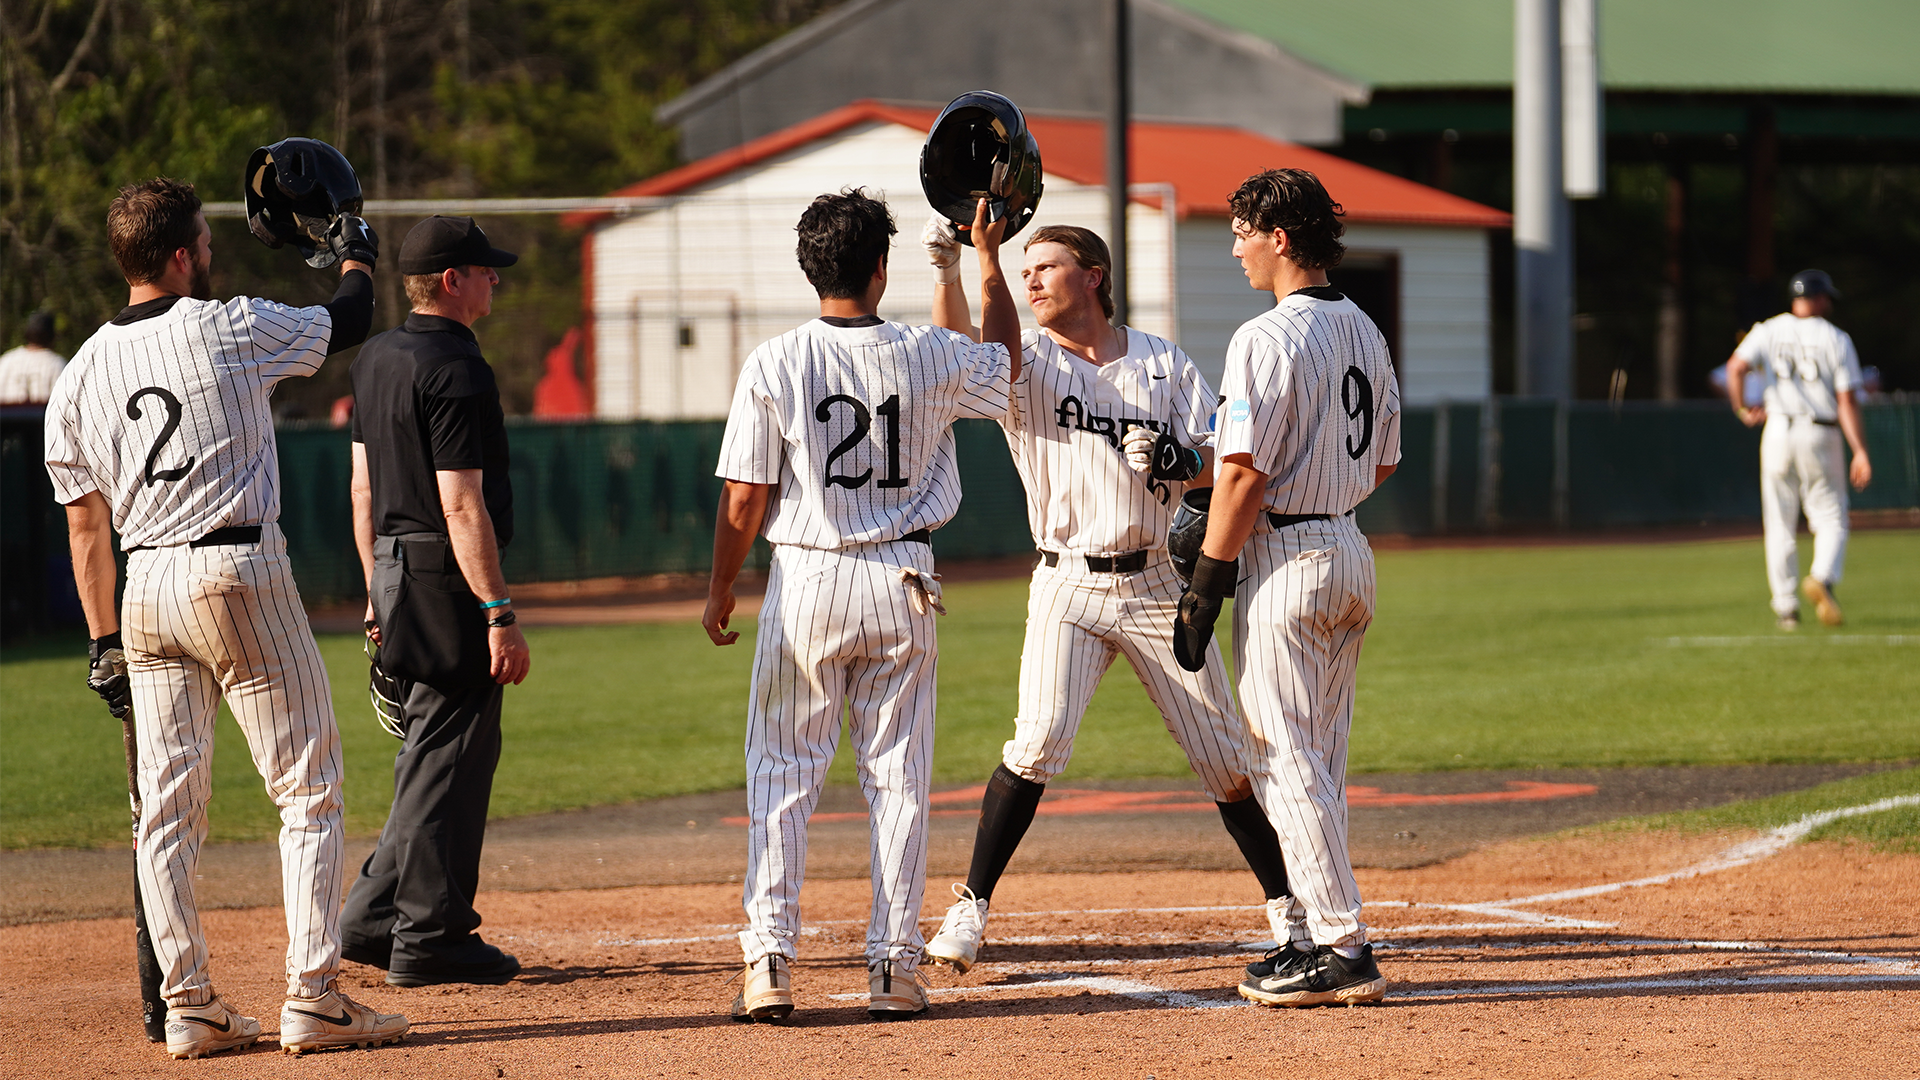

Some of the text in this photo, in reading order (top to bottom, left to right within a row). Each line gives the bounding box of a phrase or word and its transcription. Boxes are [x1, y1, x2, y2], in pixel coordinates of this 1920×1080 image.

[126, 386, 195, 488] 2
[815, 394, 908, 489] 21
[1341, 365, 1374, 460] 9
